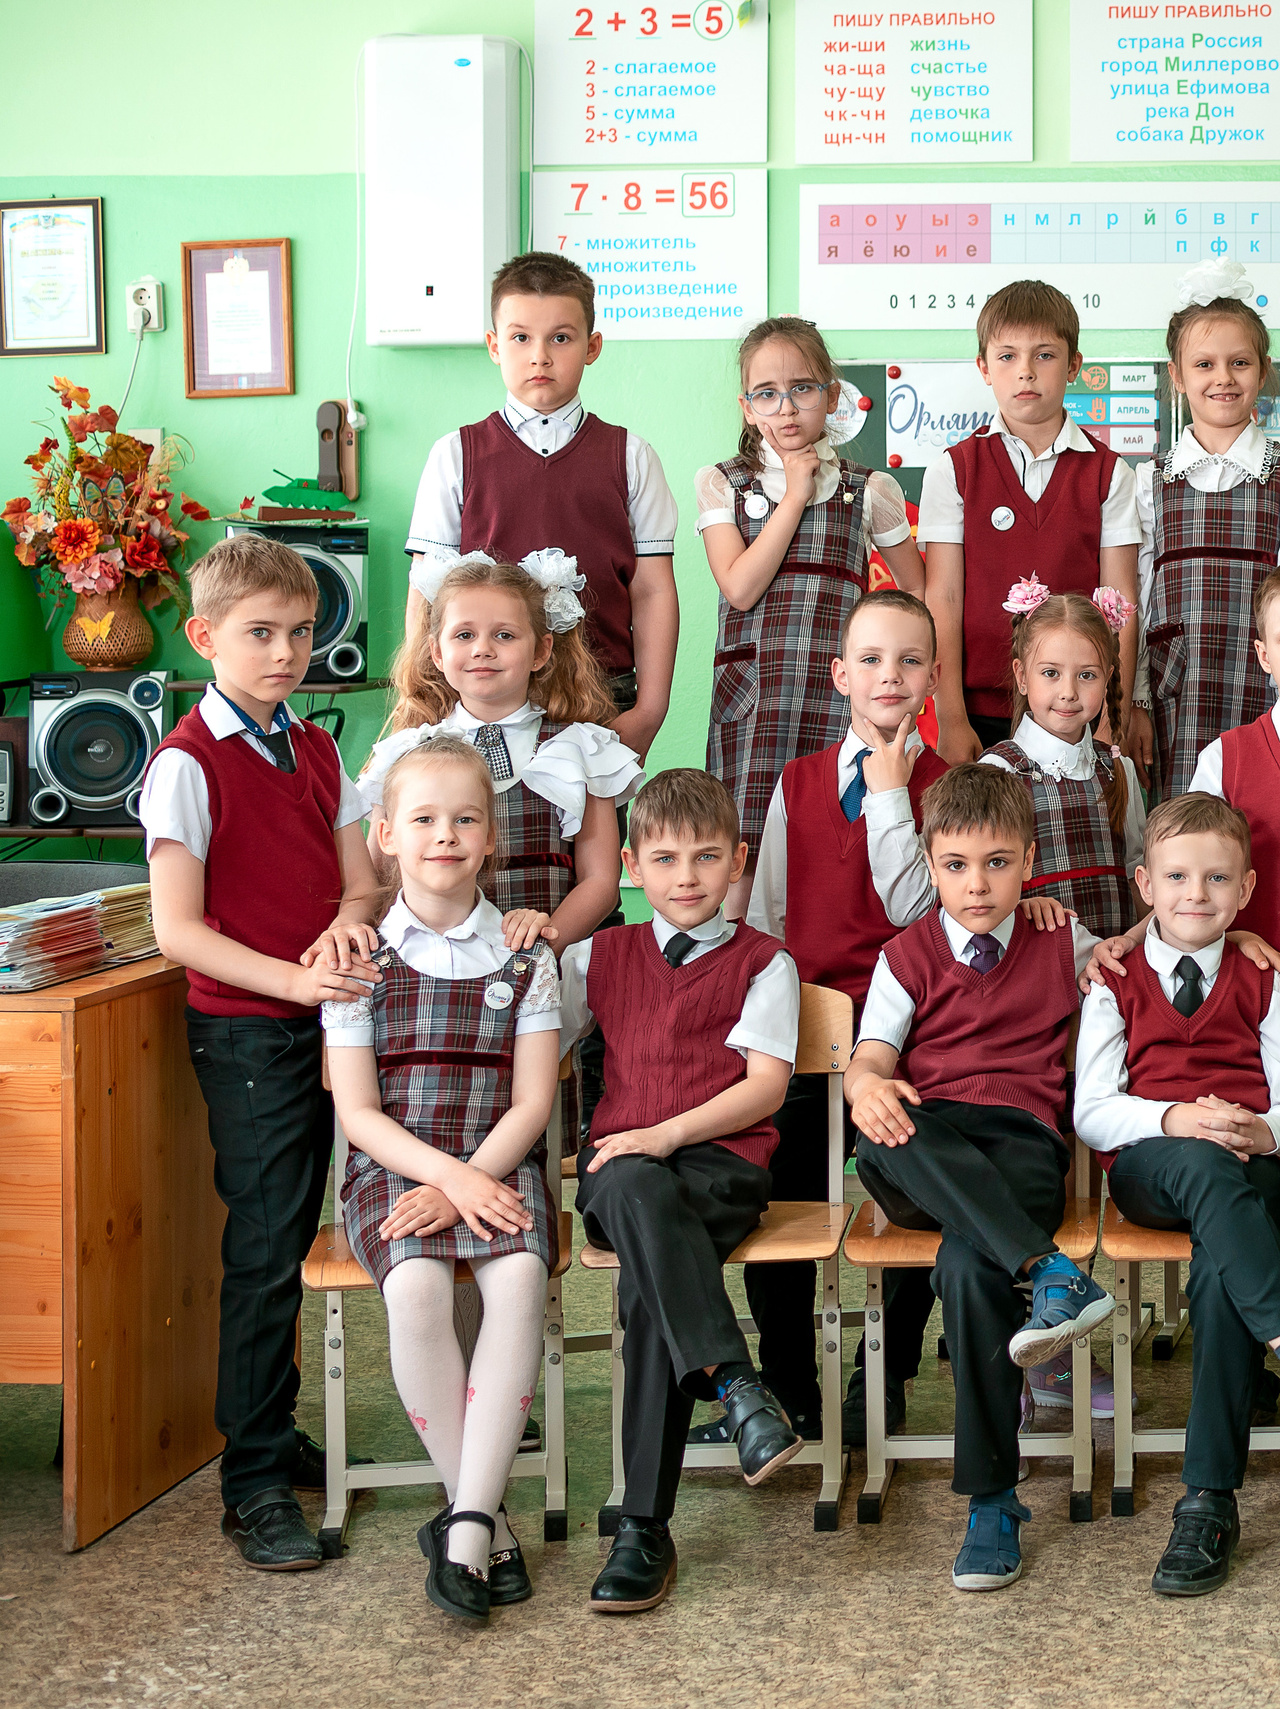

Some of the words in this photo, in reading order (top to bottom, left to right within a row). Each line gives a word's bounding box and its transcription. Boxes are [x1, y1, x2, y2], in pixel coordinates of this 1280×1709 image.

[834, 14, 883, 26] ПИШУ
[890, 12, 995, 26] ПРАВИЛЬНО
[1109, 6, 1159, 18] ПИШУ
[1165, 4, 1271, 18] ПРАВИЛЬНО
[575, 8, 593, 36] 2
[640, 7, 657, 35] 3
[705, 7, 723, 34] 5
[824, 41, 884, 52] жи-ши
[911, 40, 970, 51] жизнь
[1118, 37, 1184, 52] страна
[1193, 33, 1262, 48] Россия
[586, 60, 595, 74] 2
[615, 62, 716, 74] слагаемое
[825, 64, 885, 77] ча-ща
[911, 62, 987, 74] счастье
[1102, 61, 1158, 76] город
[1166, 57, 1279, 74] Миллерово
[586, 83, 595, 97] 3
[615, 85, 715, 97] слагаемое
[825, 87, 885, 102] чу-щу
[911, 85, 989, 101] чувство
[1111, 84, 1169, 99] улица
[1177, 80, 1269, 98] Ефимова
[586, 106, 595, 120] 5
[615, 108, 674, 123] сумма
[910, 108, 989, 122] девочка
[1146, 107, 1189, 122] река
[1196, 103, 1234, 120] Дон
[585, 128, 617, 143] 2+3
[637, 131, 697, 146] сумма
[825, 133, 885, 146] щн-чн
[911, 131, 1012, 144] помощник
[1117, 126, 1183, 141] собака
[1190, 126, 1264, 144] Дружок
[571, 183, 588, 211] 7
[624, 182, 641, 210] 8
[689, 181, 728, 209] 56
[830, 215, 840, 227] а
[865, 214, 877, 227] о
[896, 214, 907, 231] у
[932, 214, 948, 226] ы
[968, 214, 978, 226] э
[1005, 214, 1014, 225] н
[1036, 214, 1048, 225] м
[1069, 214, 1080, 225] л
[1107, 213, 1118, 229] р
[1145, 209, 1155, 225] й
[1176, 209, 1187, 225] б
[1214, 213, 1225, 224] в
[1251, 213, 1259, 224] г
[558, 236, 567, 250] 7
[587, 238, 695, 250] множитель
[827, 246, 838, 257] я
[863, 241, 874, 257] ё
[894, 245, 910, 257] ю
[936, 245, 947, 257] и
[966, 245, 977, 257] е
[1177, 241, 1186, 252] п
[1211, 236, 1227, 256] ф
[1251, 240, 1259, 252] к
[587, 261, 696, 272] множитель
[598, 283, 737, 299] произведение
[890, 295, 898, 308] 0
[910, 295, 915, 308] 1
[928, 295, 936, 308] 2
[948, 294, 955, 308] 3
[966, 294, 975, 308] 4
[1083, 294, 1100, 308] 10
[604, 306, 743, 322] произведение
[888, 384, 995, 439] Орлят
[1123, 435, 1143, 444] МАЙ
